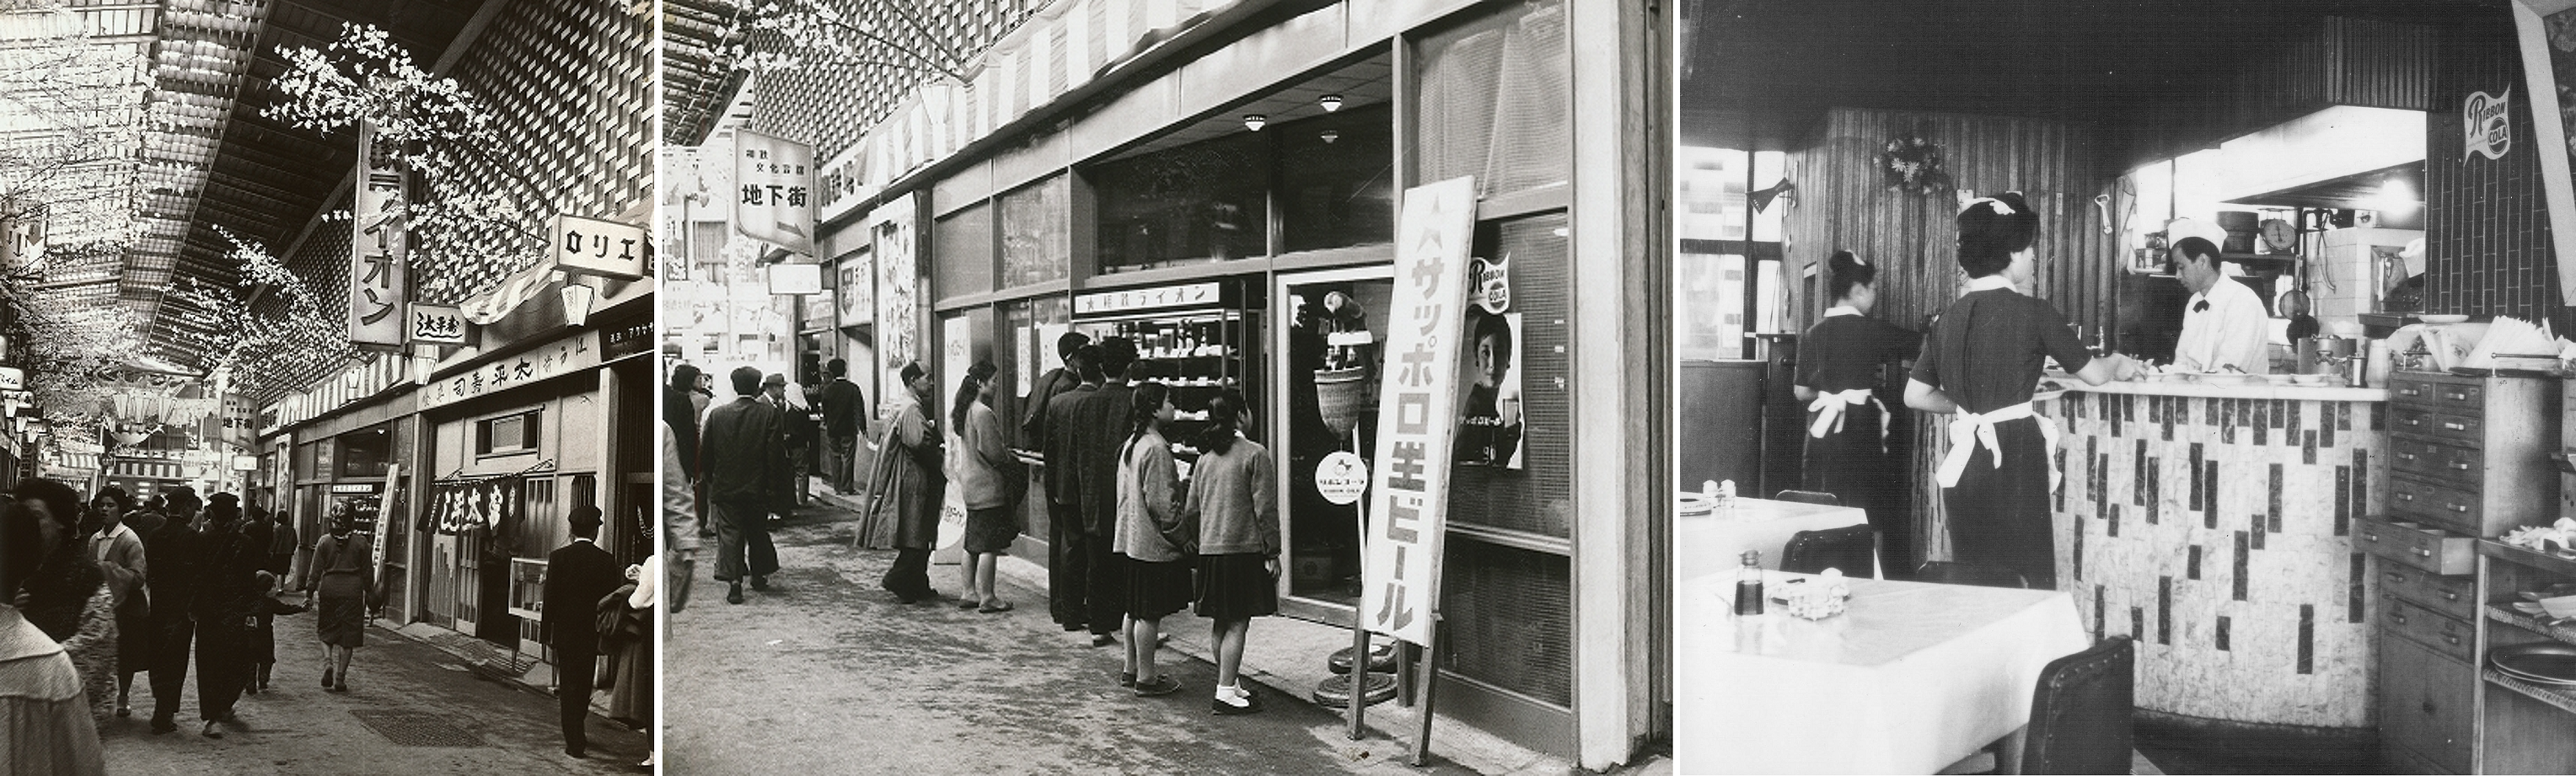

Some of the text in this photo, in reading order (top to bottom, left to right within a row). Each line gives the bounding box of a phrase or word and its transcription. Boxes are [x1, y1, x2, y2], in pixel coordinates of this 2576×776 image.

[2467, 94, 2506, 138] RIBBON
[2489, 126, 2507, 144] COLA
[741, 184, 807, 208] 地下街
[1469, 260, 1505, 295] RIBBON
[1377, 257, 1444, 631] サッポロ生ビール
